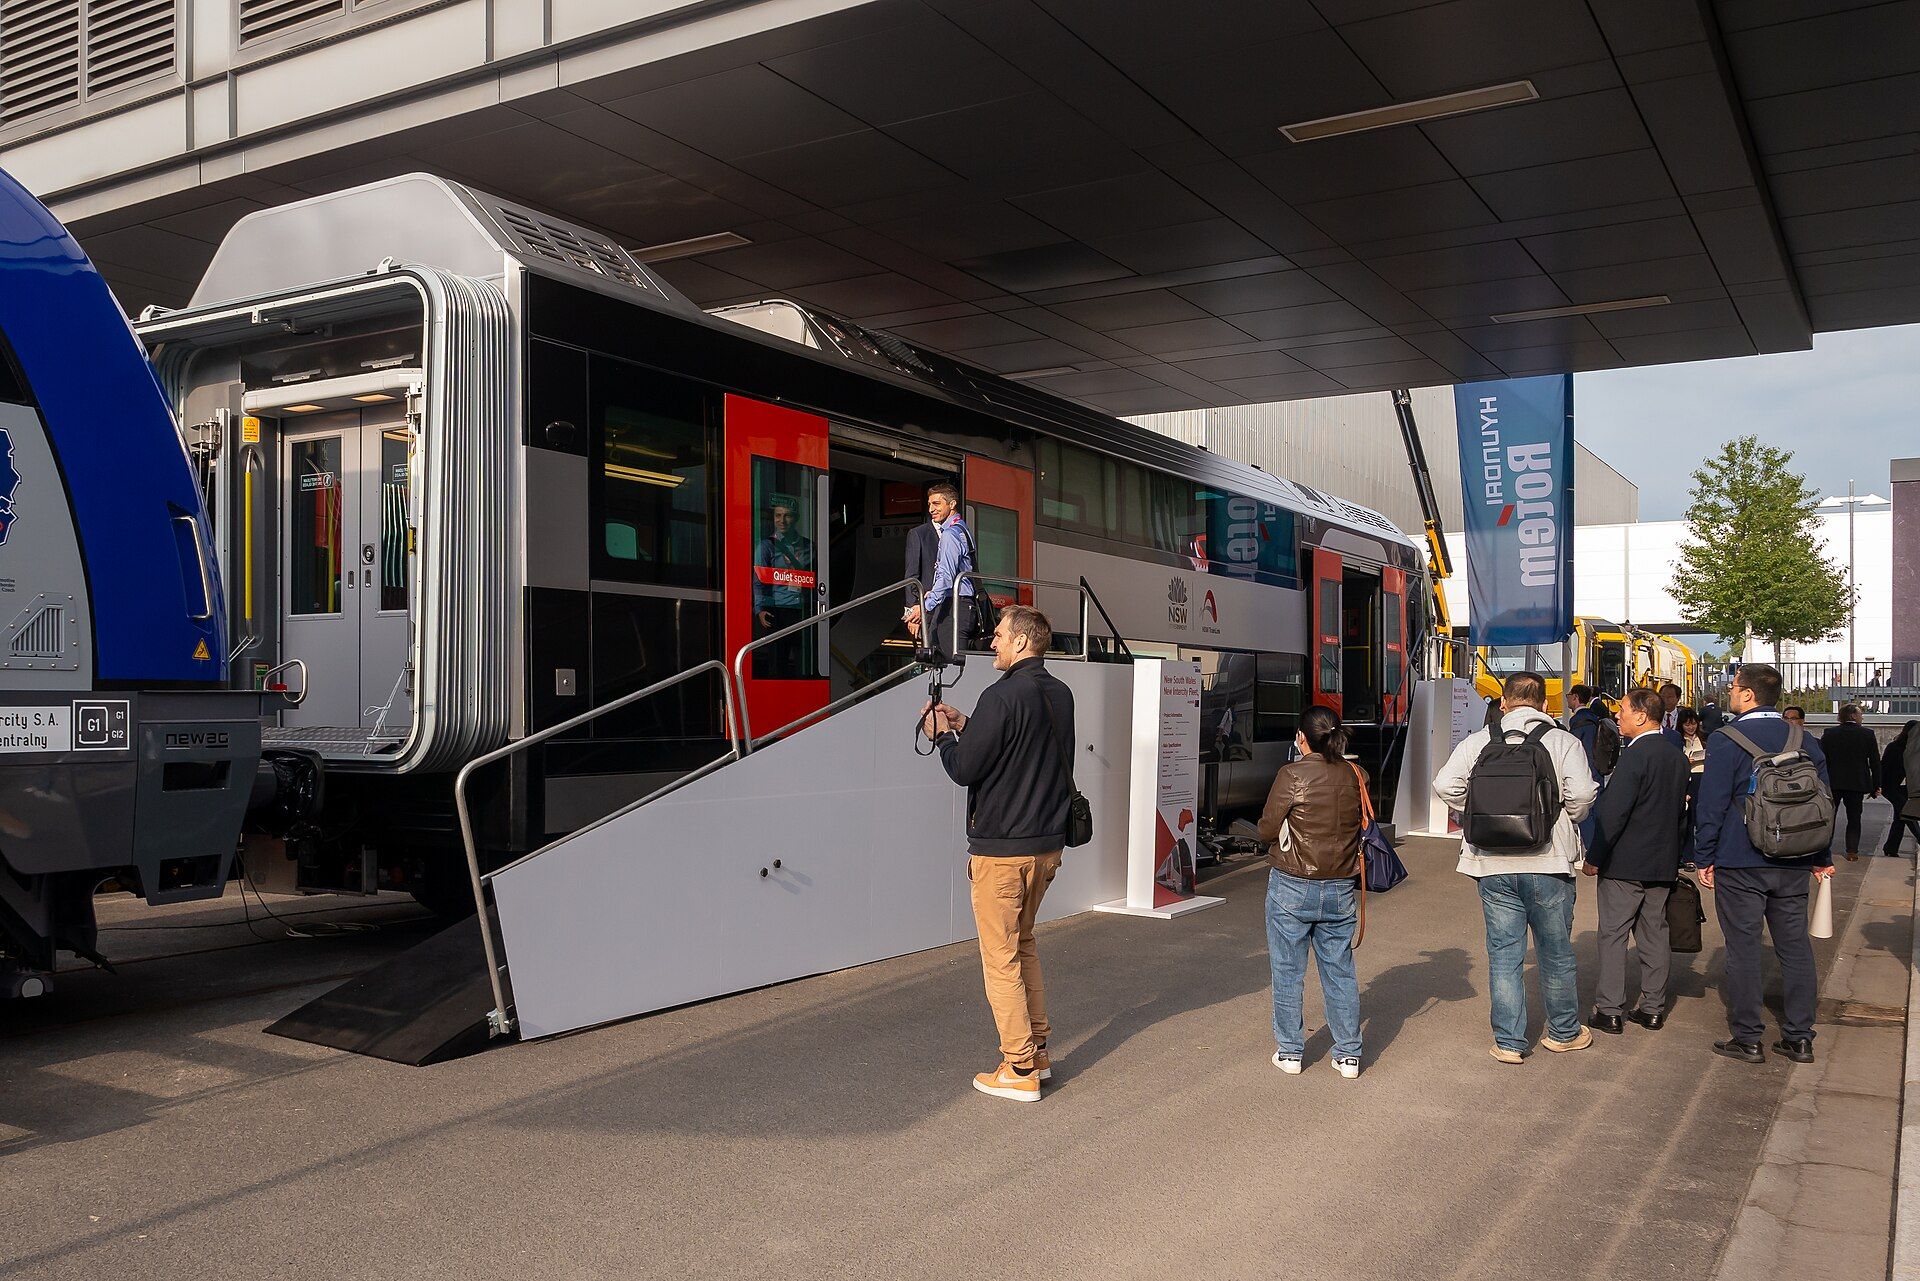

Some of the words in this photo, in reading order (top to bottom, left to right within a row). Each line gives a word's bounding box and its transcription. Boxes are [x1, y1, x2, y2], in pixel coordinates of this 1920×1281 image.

[773, 571, 793, 582] Quiet
[793, 574, 814, 584] space
[1168, 606, 1188, 624] NSW
[1163, 675, 1172, 684] New
[1173, 675, 1185, 684] South
[1186, 676, 1197, 685] Wales
[1163, 687, 1172, 696] New
[1172, 687, 1188, 697] Intercity
[33, 712, 45, 726] S.
[48, 712, 59, 726] A.
[115, 711, 124, 720] G1
[87, 718, 100, 732] G1
[165, 732, 229, 747] newag
